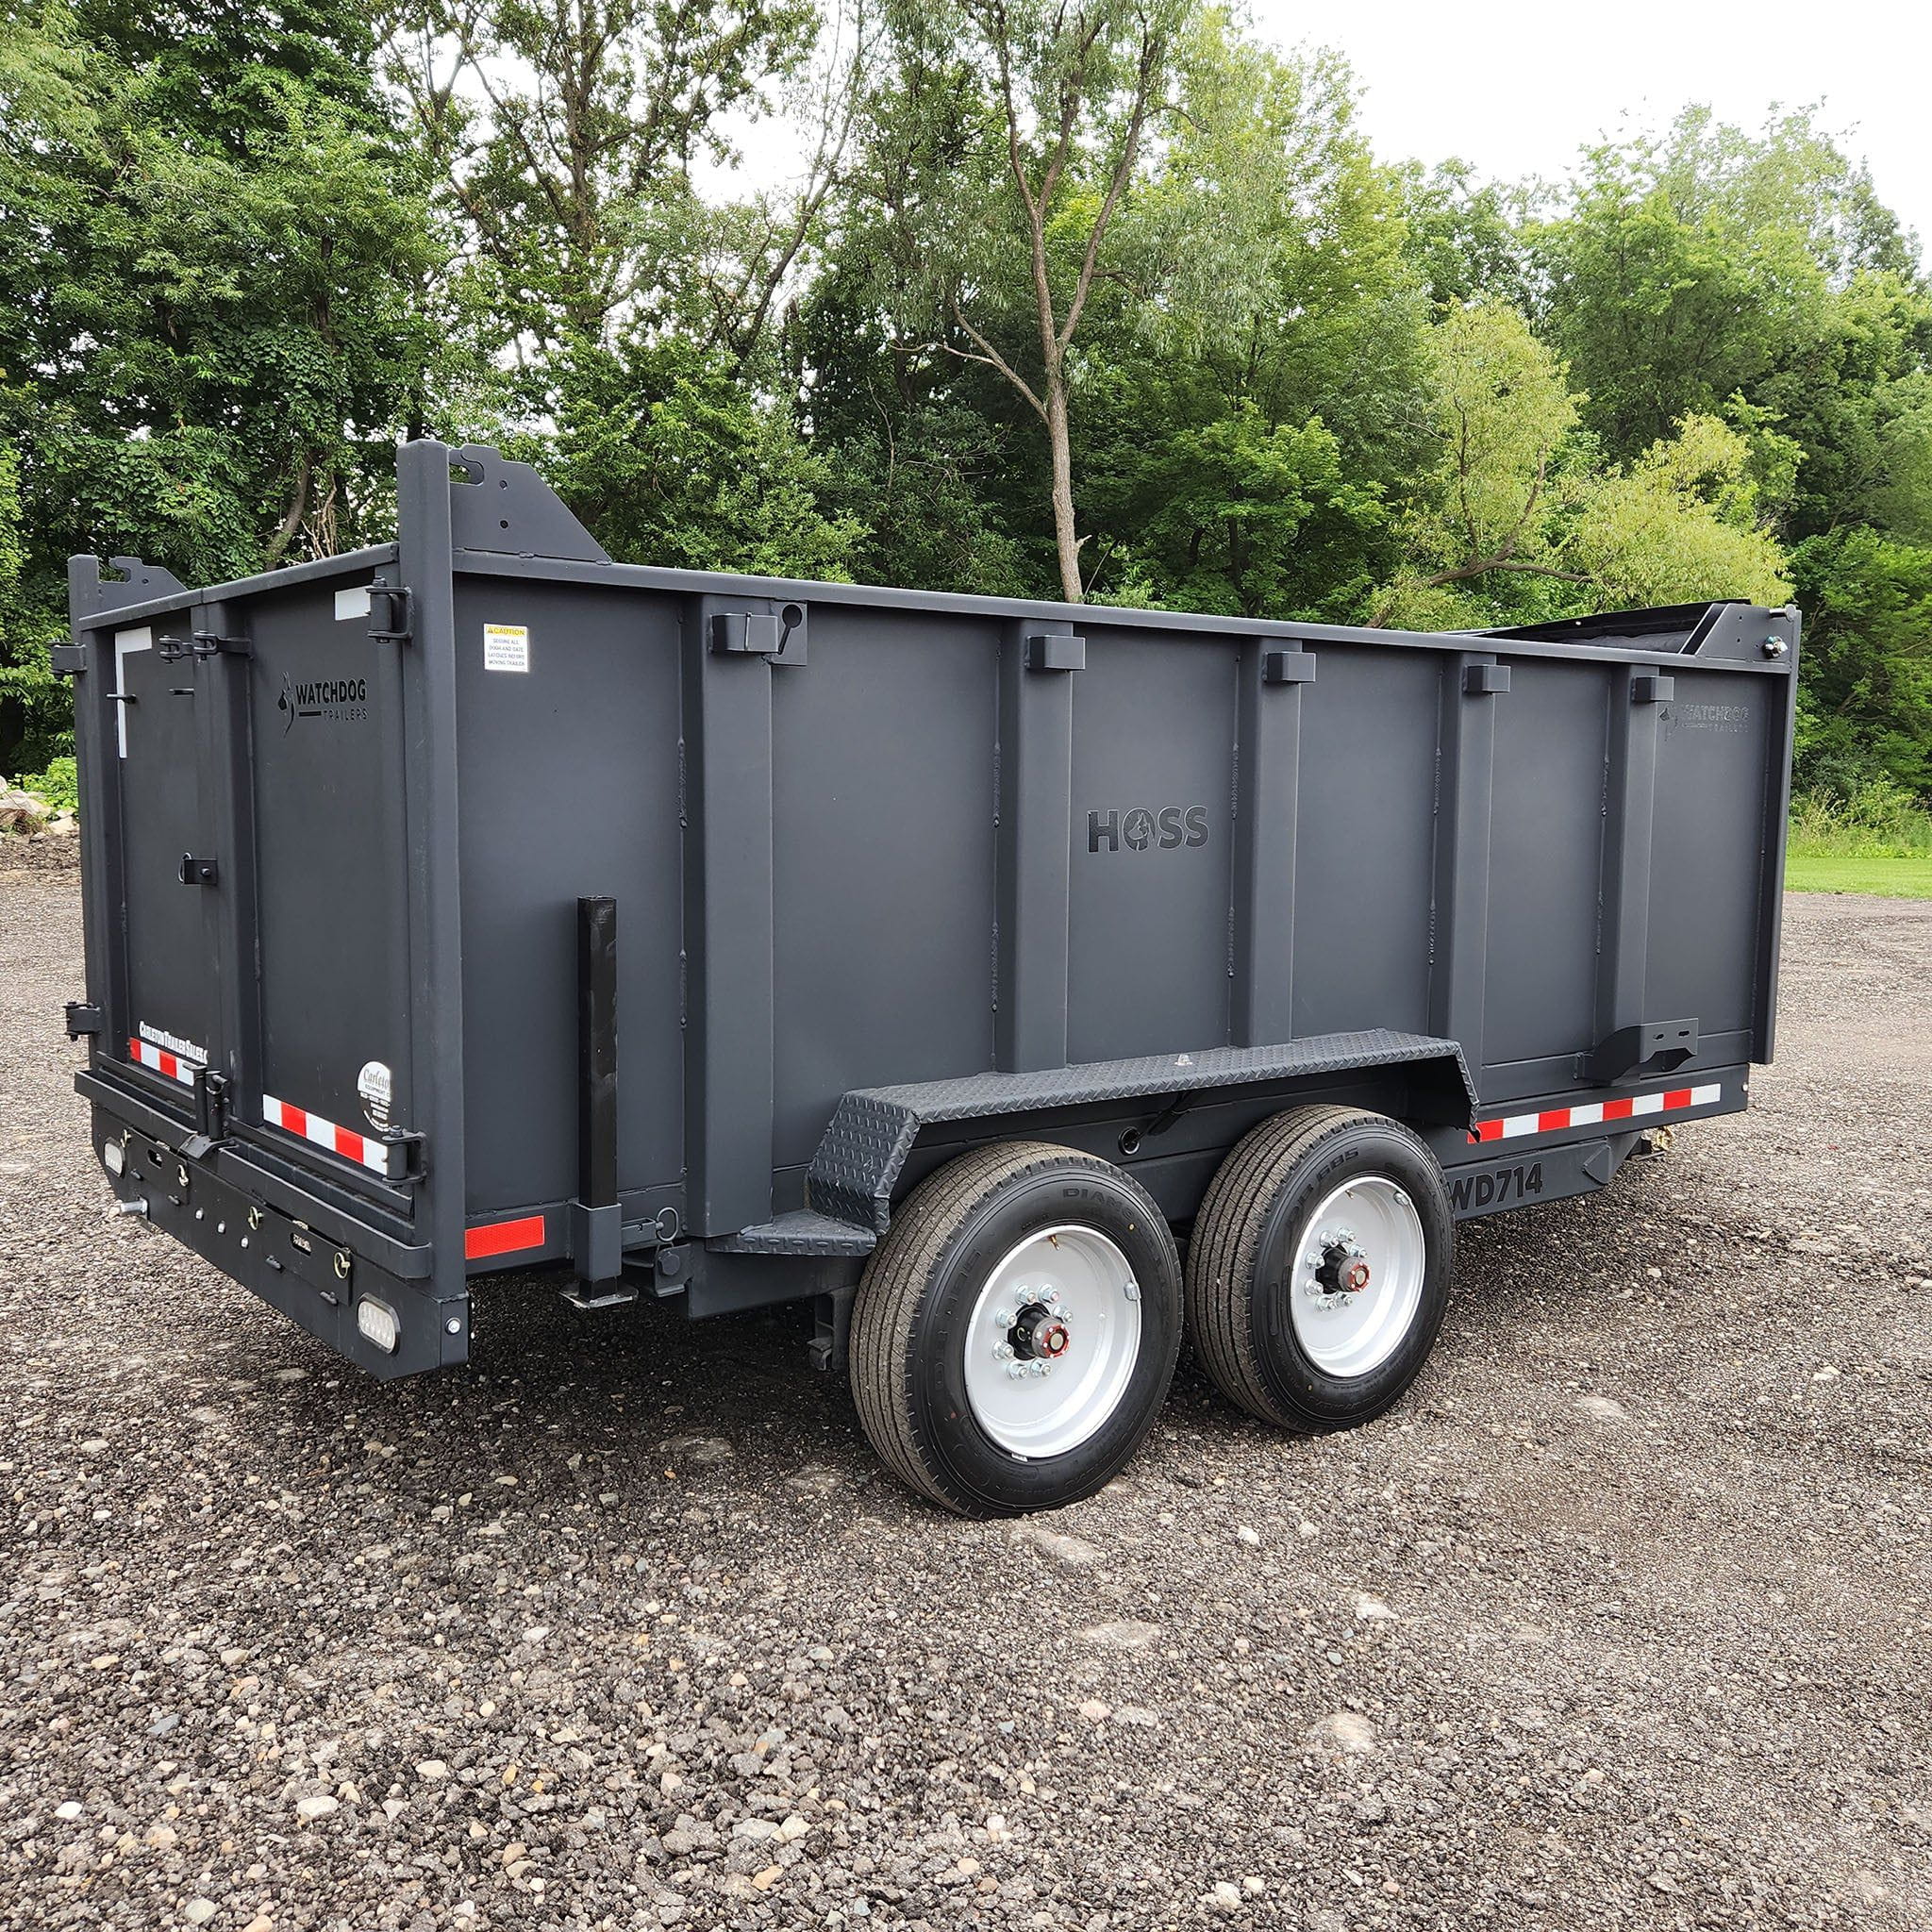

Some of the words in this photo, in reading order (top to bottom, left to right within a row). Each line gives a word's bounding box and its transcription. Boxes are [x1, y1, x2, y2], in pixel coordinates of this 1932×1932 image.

[295, 679, 366, 705] WATCHDOG
[324, 708, 367, 721] TRAILERS
[1087, 805, 1209, 854] HOSS
[1448, 1161, 1543, 1211] WD714
